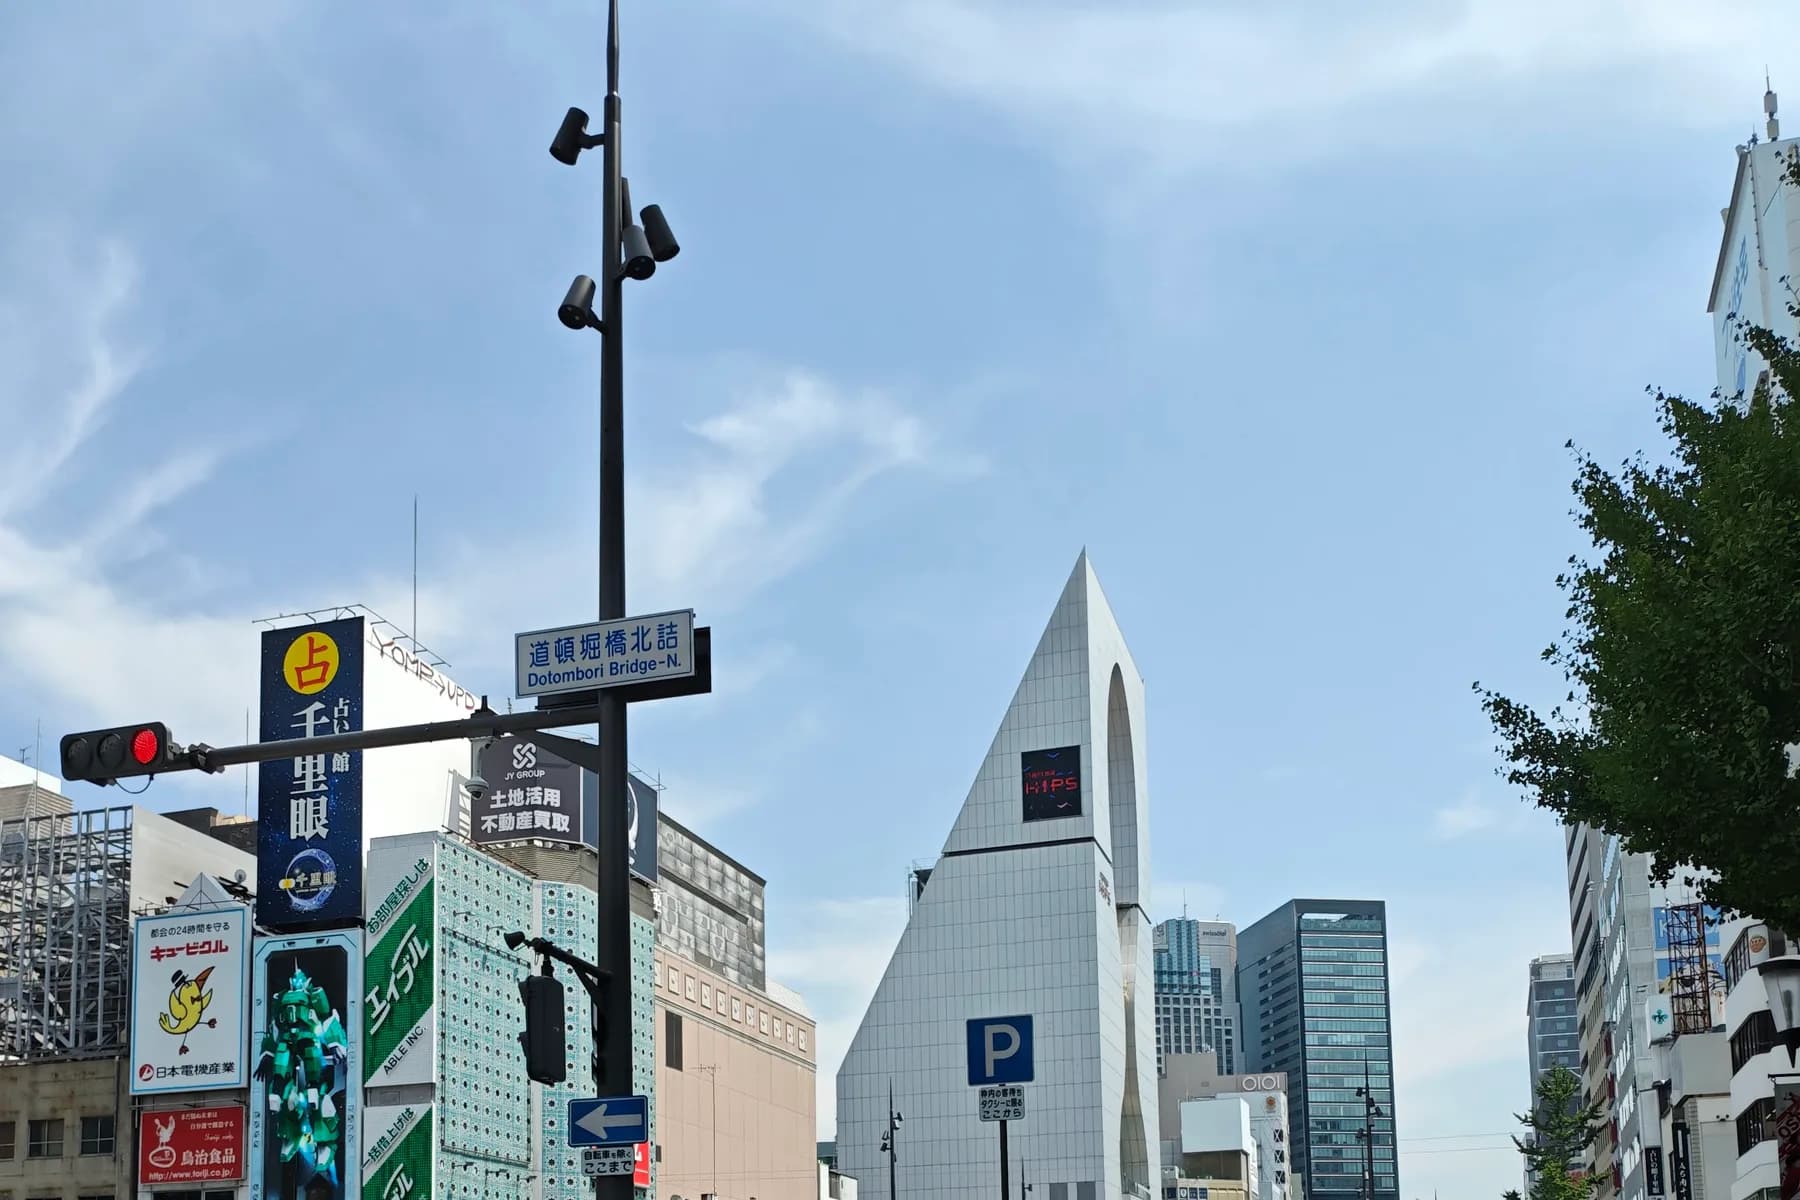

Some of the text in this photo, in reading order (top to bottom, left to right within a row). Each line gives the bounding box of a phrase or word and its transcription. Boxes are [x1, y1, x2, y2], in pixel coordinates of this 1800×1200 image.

[529, 621, 678, 668] 道頓堀橋北詰
[294, 636, 331, 690] 占
[528, 653, 681, 687] Dotombori Bridge-N.
[332, 697, 350, 774] 占い館
[290, 700, 331, 841] 千里眼
[504, 769, 545, 781] JY GROUP
[489, 786, 561, 809] 土地活用
[480, 810, 570, 834] 不動産買取
[367, 857, 431, 934] お部屋探しは
[150, 921, 231, 939] 都会の24時間を守る
[150, 939, 229, 962] キュービクル
[365, 923, 430, 1036] エイブル
[383, 1043, 409, 1075] ABLE
[984, 1024, 1020, 1077] P
[156, 1061, 235, 1079] 日本電機産業
[584, 1148, 631, 1161] 自転車を除く
[584, 1160, 632, 1174] ここまで
